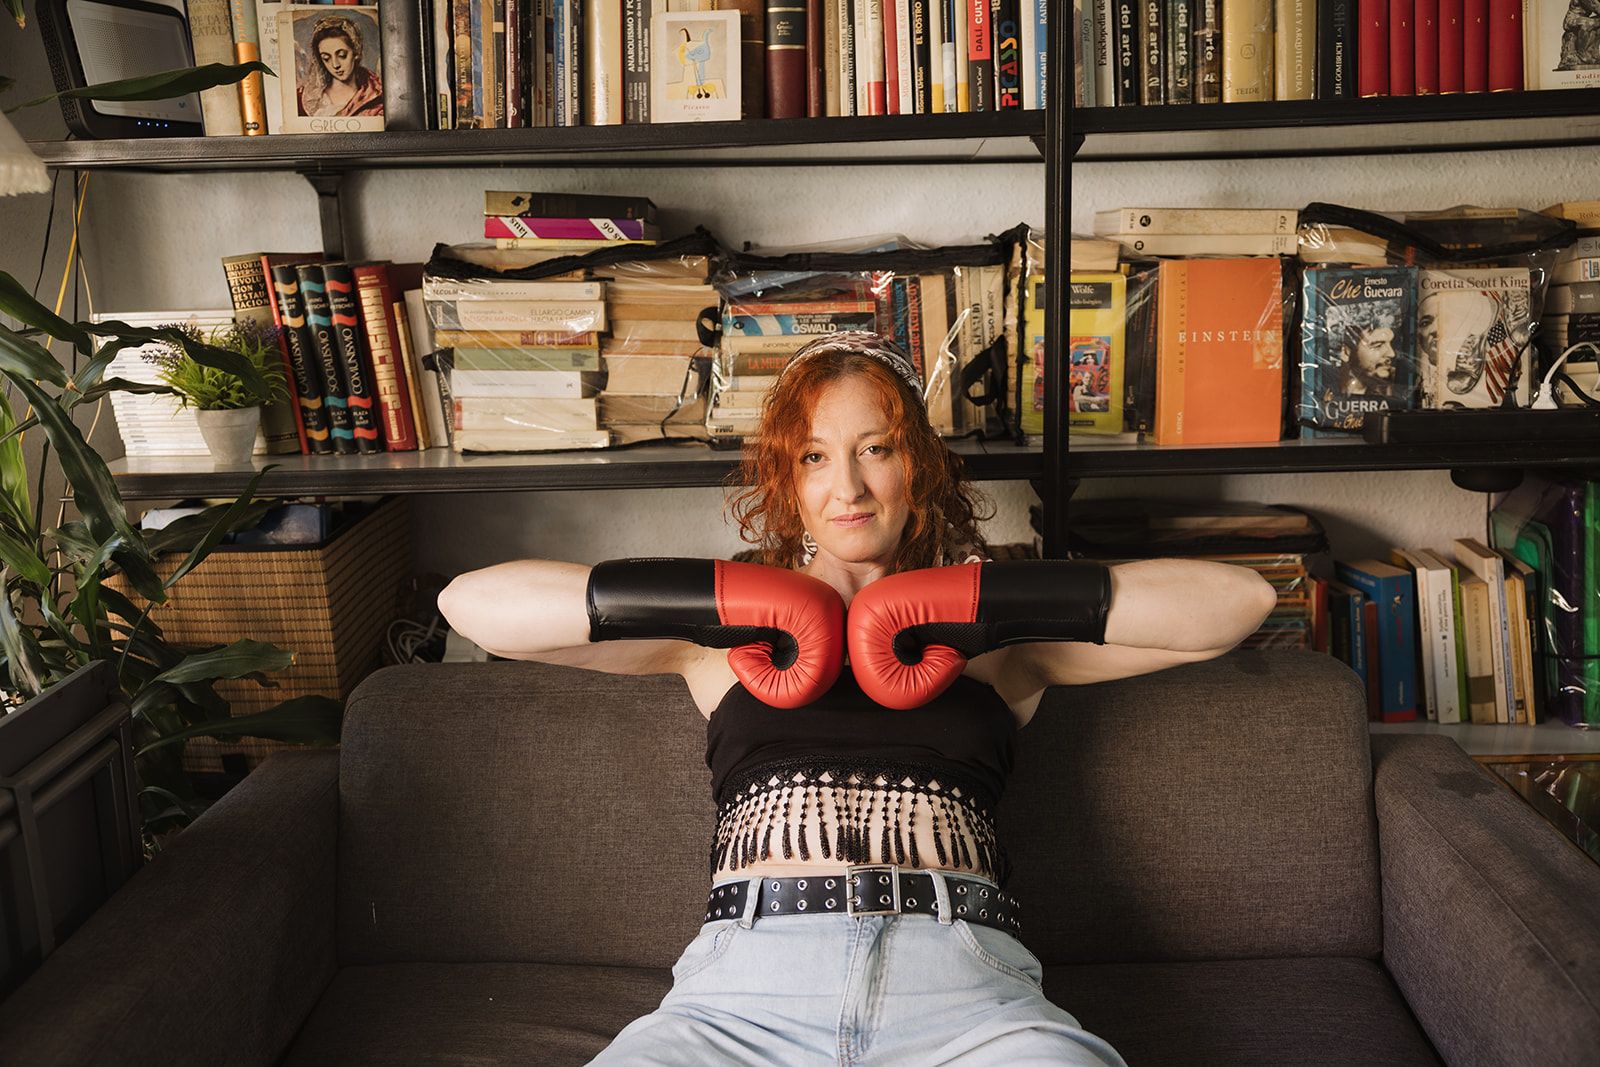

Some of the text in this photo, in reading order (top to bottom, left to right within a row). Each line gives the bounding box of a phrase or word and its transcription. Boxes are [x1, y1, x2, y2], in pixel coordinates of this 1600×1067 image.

[915, 1, 923, 45] EL ROSTRO
[627, 17, 635, 72] ANARQUISMO
[1098, 13, 1107, 67] Enciclopedia
[1120, 4, 1131, 89] del arte 1
[1148, 2, 1160, 87] del arte 2
[1176, 3, 1189, 88] del arte 3
[1205, 30, 1216, 61] arte
[1294, 27, 1303, 92] ARQUITECTURA
[1203, 73, 1216, 83] 4
[1235, 87, 1260, 96] TEIDE
[310, 118, 361, 131] GRECO
[1071, 285, 1095, 294] Wolfe
[1331, 277, 1388, 300] Che Ernesto
[1364, 286, 1403, 299] Guevara
[1421, 276, 1528, 291] Coretta Scott King
[908, 282, 920, 331] Kennedy
[791, 323, 837, 334] OSWALD
[1179, 329, 1277, 343] EINSTEIN
[318, 330, 340, 393] SOCIALISMO
[341, 328, 364, 394] COMUNISMO
[1325, 400, 1390, 420] GUERRA
